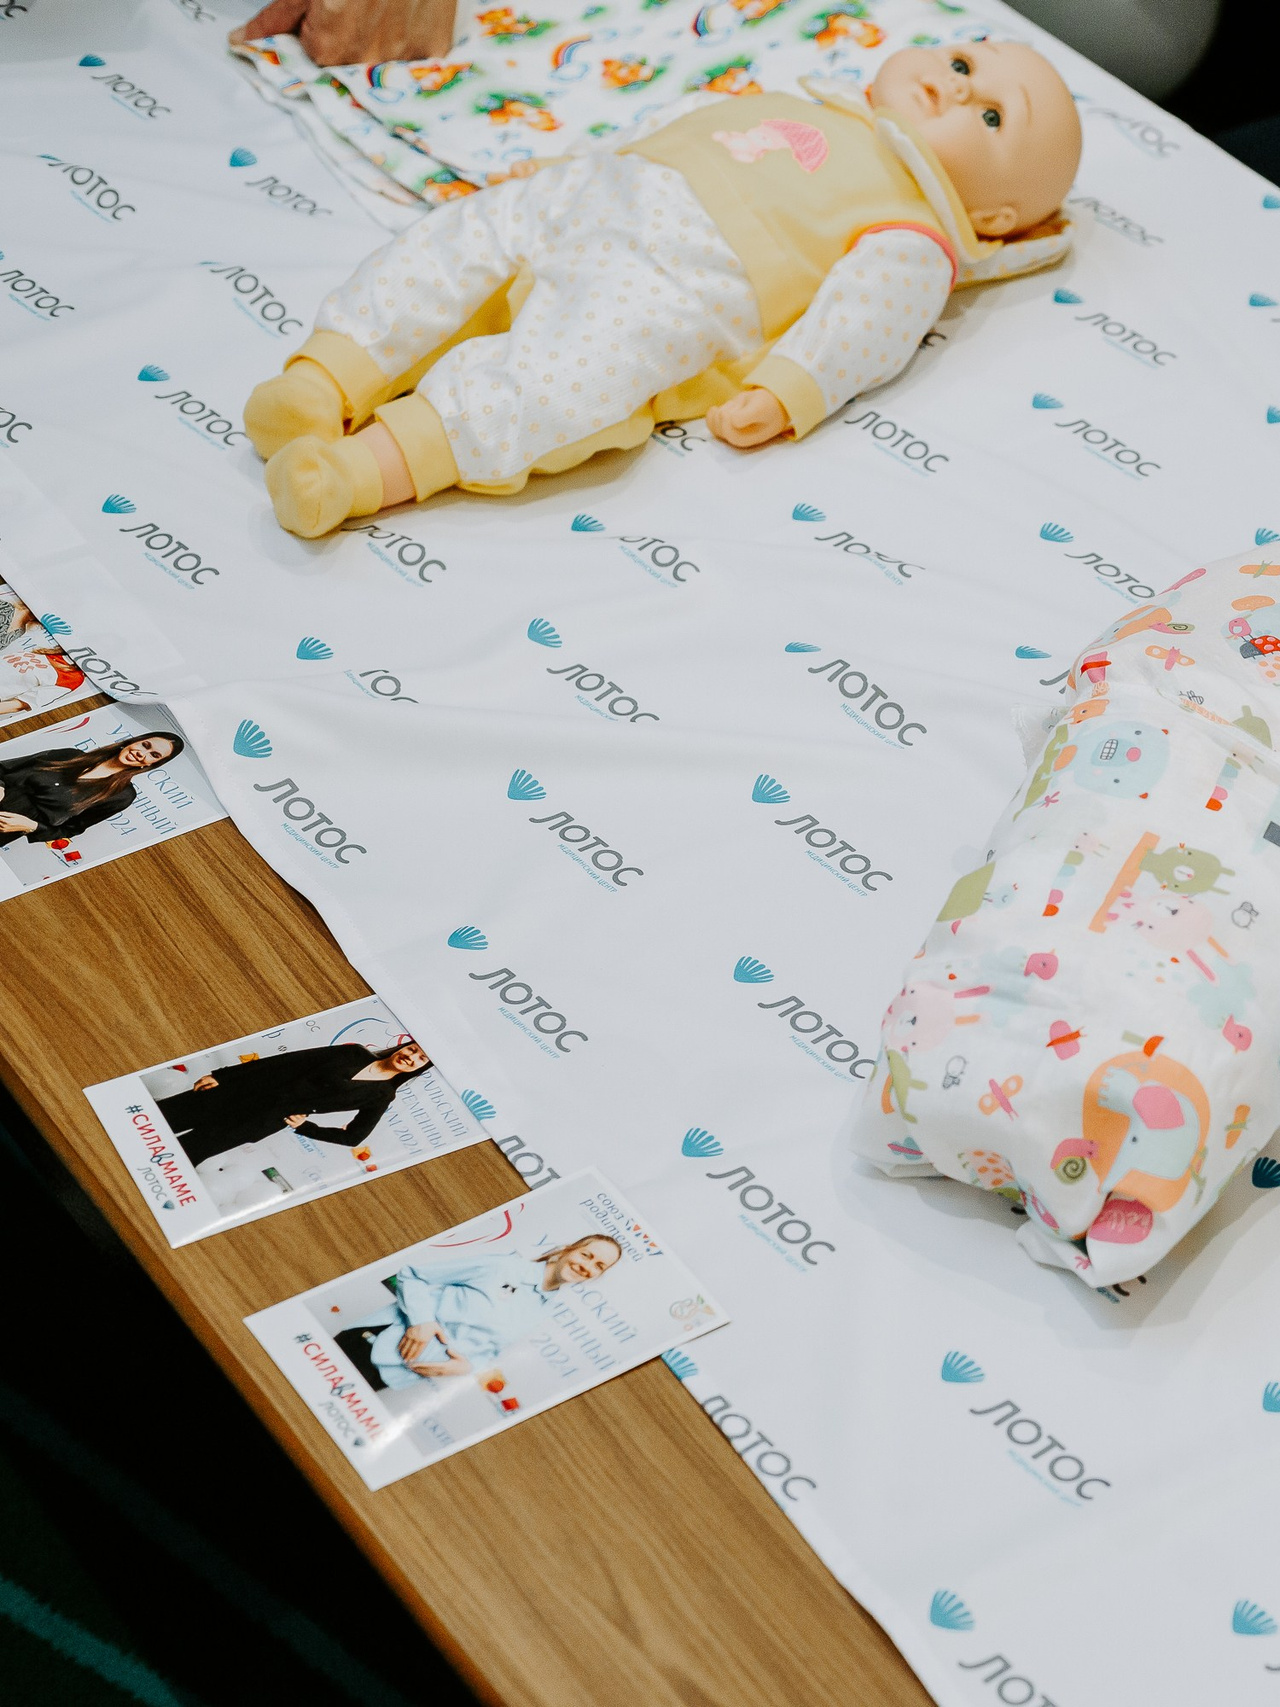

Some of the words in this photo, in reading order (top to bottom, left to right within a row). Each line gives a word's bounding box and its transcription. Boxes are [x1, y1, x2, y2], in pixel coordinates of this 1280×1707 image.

[91, 74, 171, 119] ЛОТОС
[48, 161, 136, 221] ЛОТОС
[245, 176, 333, 217] ЛОТОС
[0, 269, 75, 319] ЛОТОС
[208, 265, 304, 336] ЛОТОС
[1075, 313, 1176, 366] ЛОТОС
[155, 390, 246, 447] ЛОТОС
[845, 410, 949, 473] ЛОТОС
[1055, 419, 1161, 477] ЛОТОС
[119, 522, 220, 586] ЛОТОС
[617, 536, 701, 584] ТОС
[1064, 552, 1156, 599] ЛОТО
[808, 659, 928, 746] ЛОТОС
[253, 778, 367, 865] ЛОТОС
[529, 811, 644, 887] ЛОТОС
[775, 814, 893, 892] ЛОТОС
[468, 968, 588, 1053] ЛОТОС
[758, 995, 879, 1079] ЛОТОС
[421, 1071, 468, 1137] РАЛЬСКИЙ
[137, 1167, 168, 1201] ЛОТОС
[497, 1135, 562, 1191] ЛОТ
[580, 1199, 643, 1263] родителей
[597, 1192, 624, 1221] союз
[706, 1166, 837, 1265] ЛОТОС
[701, 1395, 817, 1501] ЛОТОС
[970, 1400, 1111, 1500] ЛОТОС
